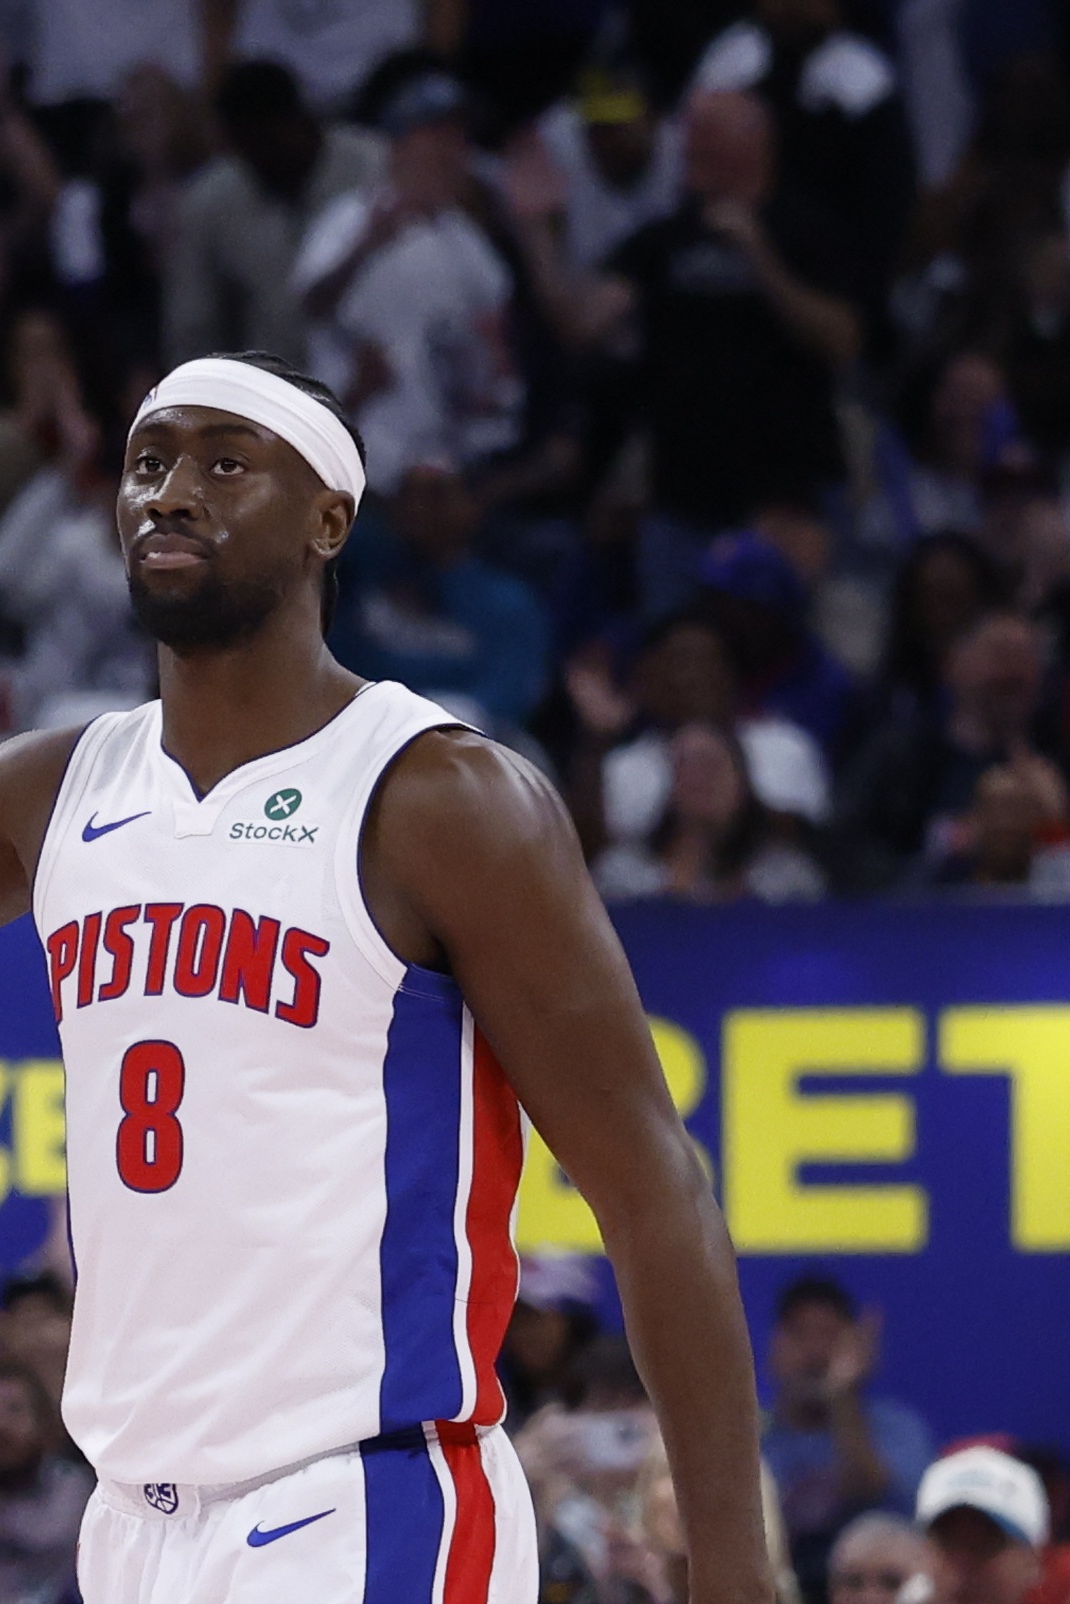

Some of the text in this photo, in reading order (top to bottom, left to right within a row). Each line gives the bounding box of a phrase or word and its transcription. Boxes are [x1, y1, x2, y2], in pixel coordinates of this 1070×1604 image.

[229, 822, 319, 843] StockX
[47, 902, 330, 1028] PISTONS
[116, 1039, 186, 1194] 8
